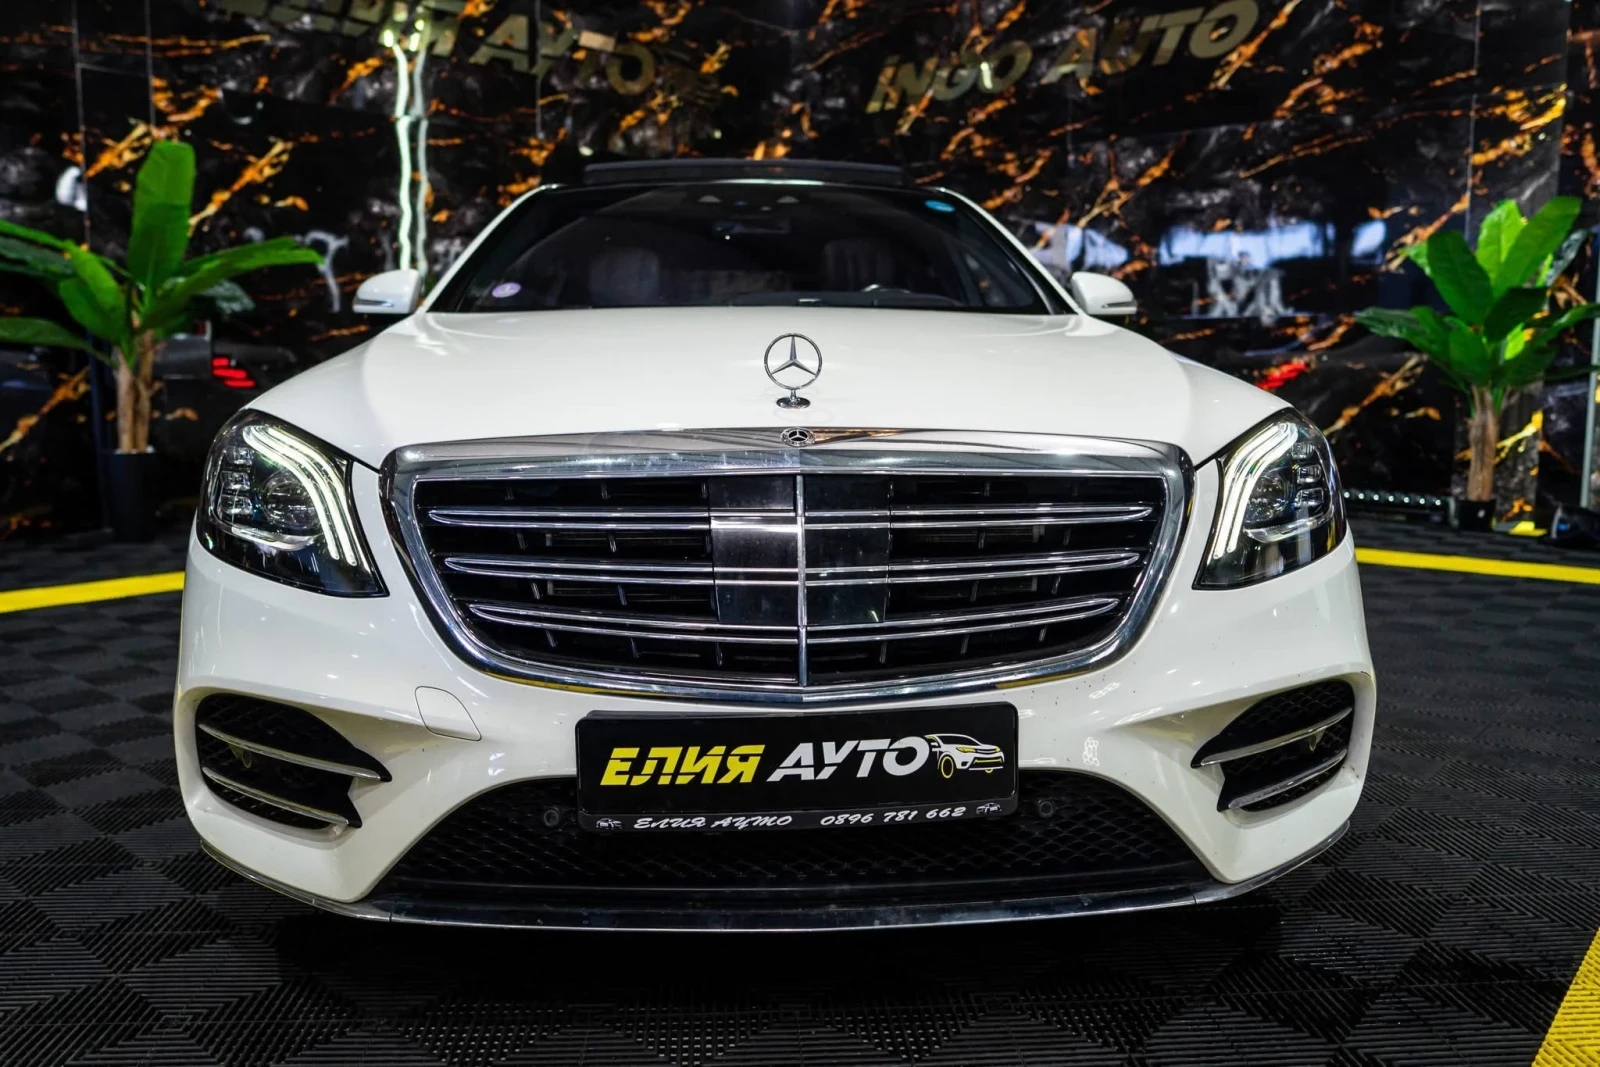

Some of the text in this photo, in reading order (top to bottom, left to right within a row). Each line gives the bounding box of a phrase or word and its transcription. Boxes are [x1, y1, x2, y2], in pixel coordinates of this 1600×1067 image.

[865, 0, 1260, 114] INGO AUTO
[600, 736, 930, 786] ЕЛИЯ АУТО
[820, 813, 874, 826] 0896
[883, 810, 918, 823] 781
[926, 806, 966, 819] 662
